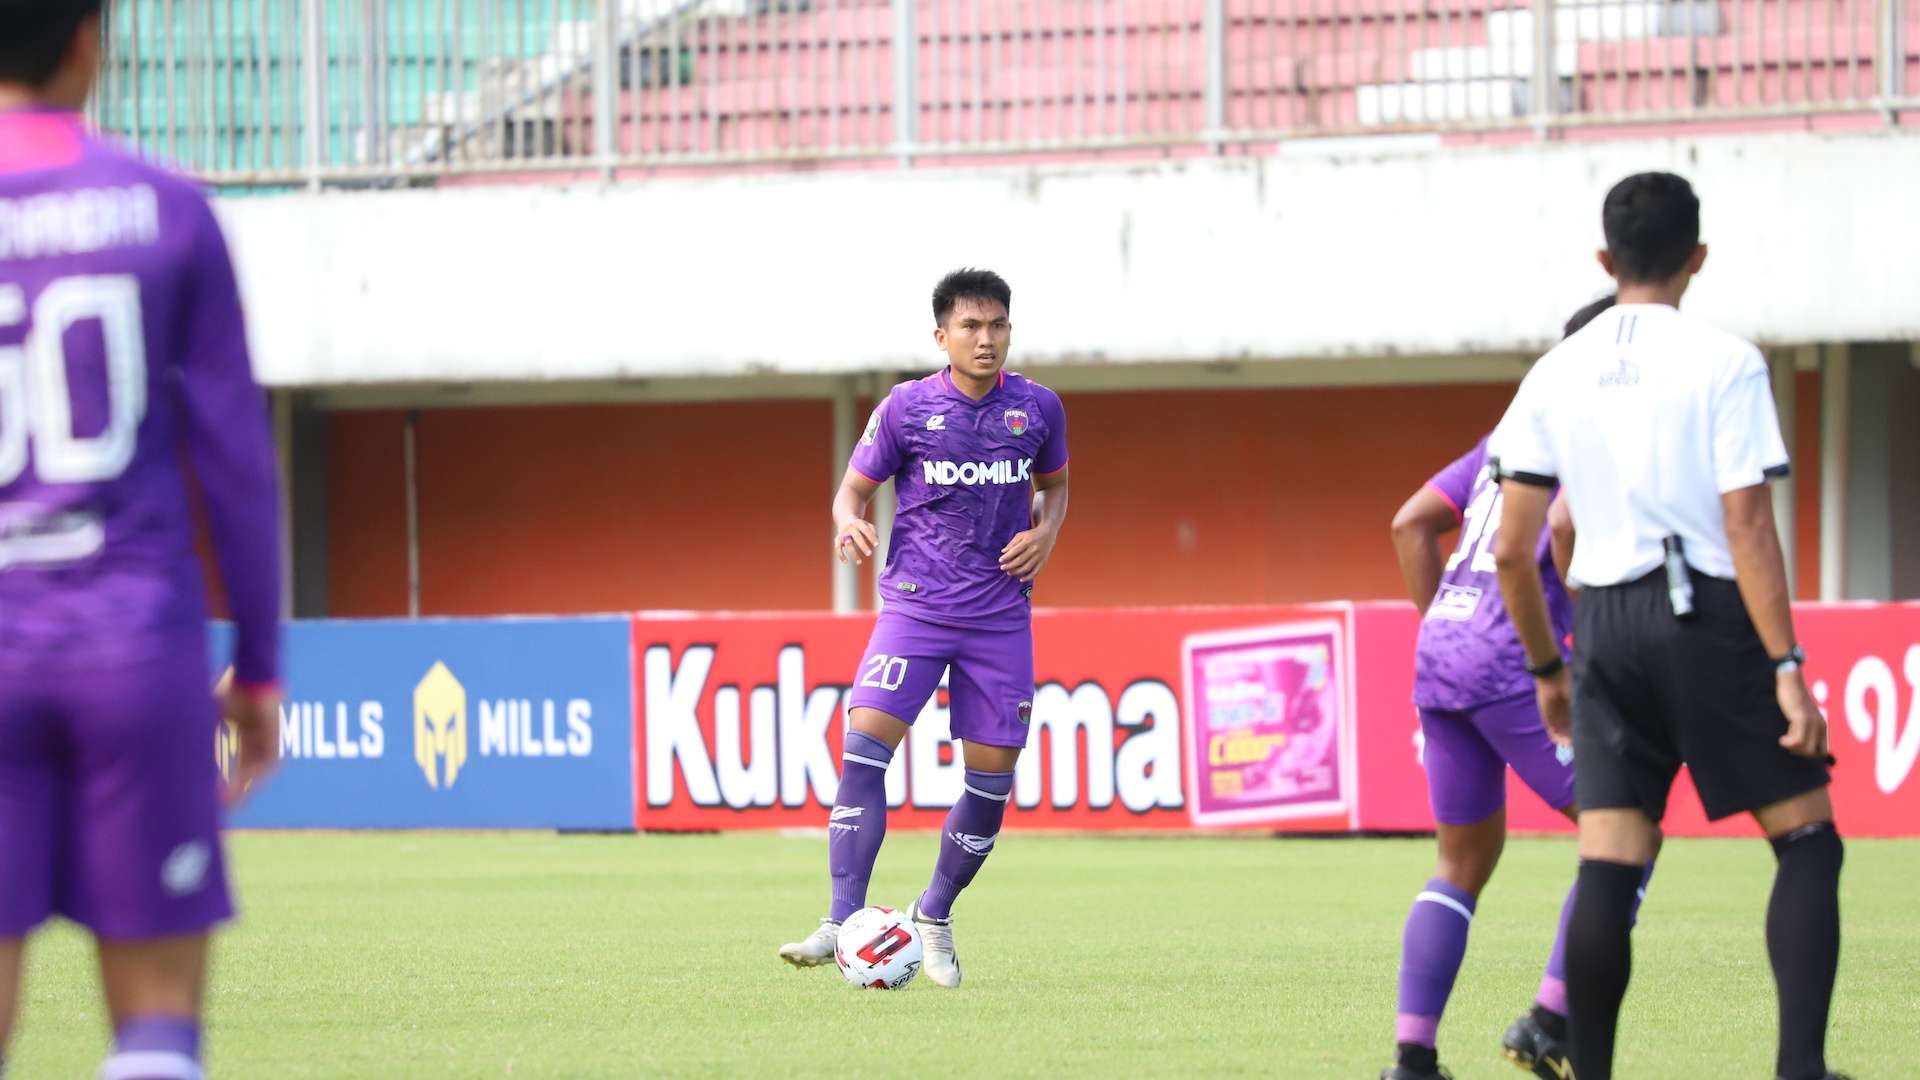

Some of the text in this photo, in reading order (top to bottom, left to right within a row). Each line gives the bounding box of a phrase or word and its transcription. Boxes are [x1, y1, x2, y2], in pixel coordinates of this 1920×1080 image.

[860, 653, 909, 692] 20
[278, 698, 593, 759] MILLS MILLS
